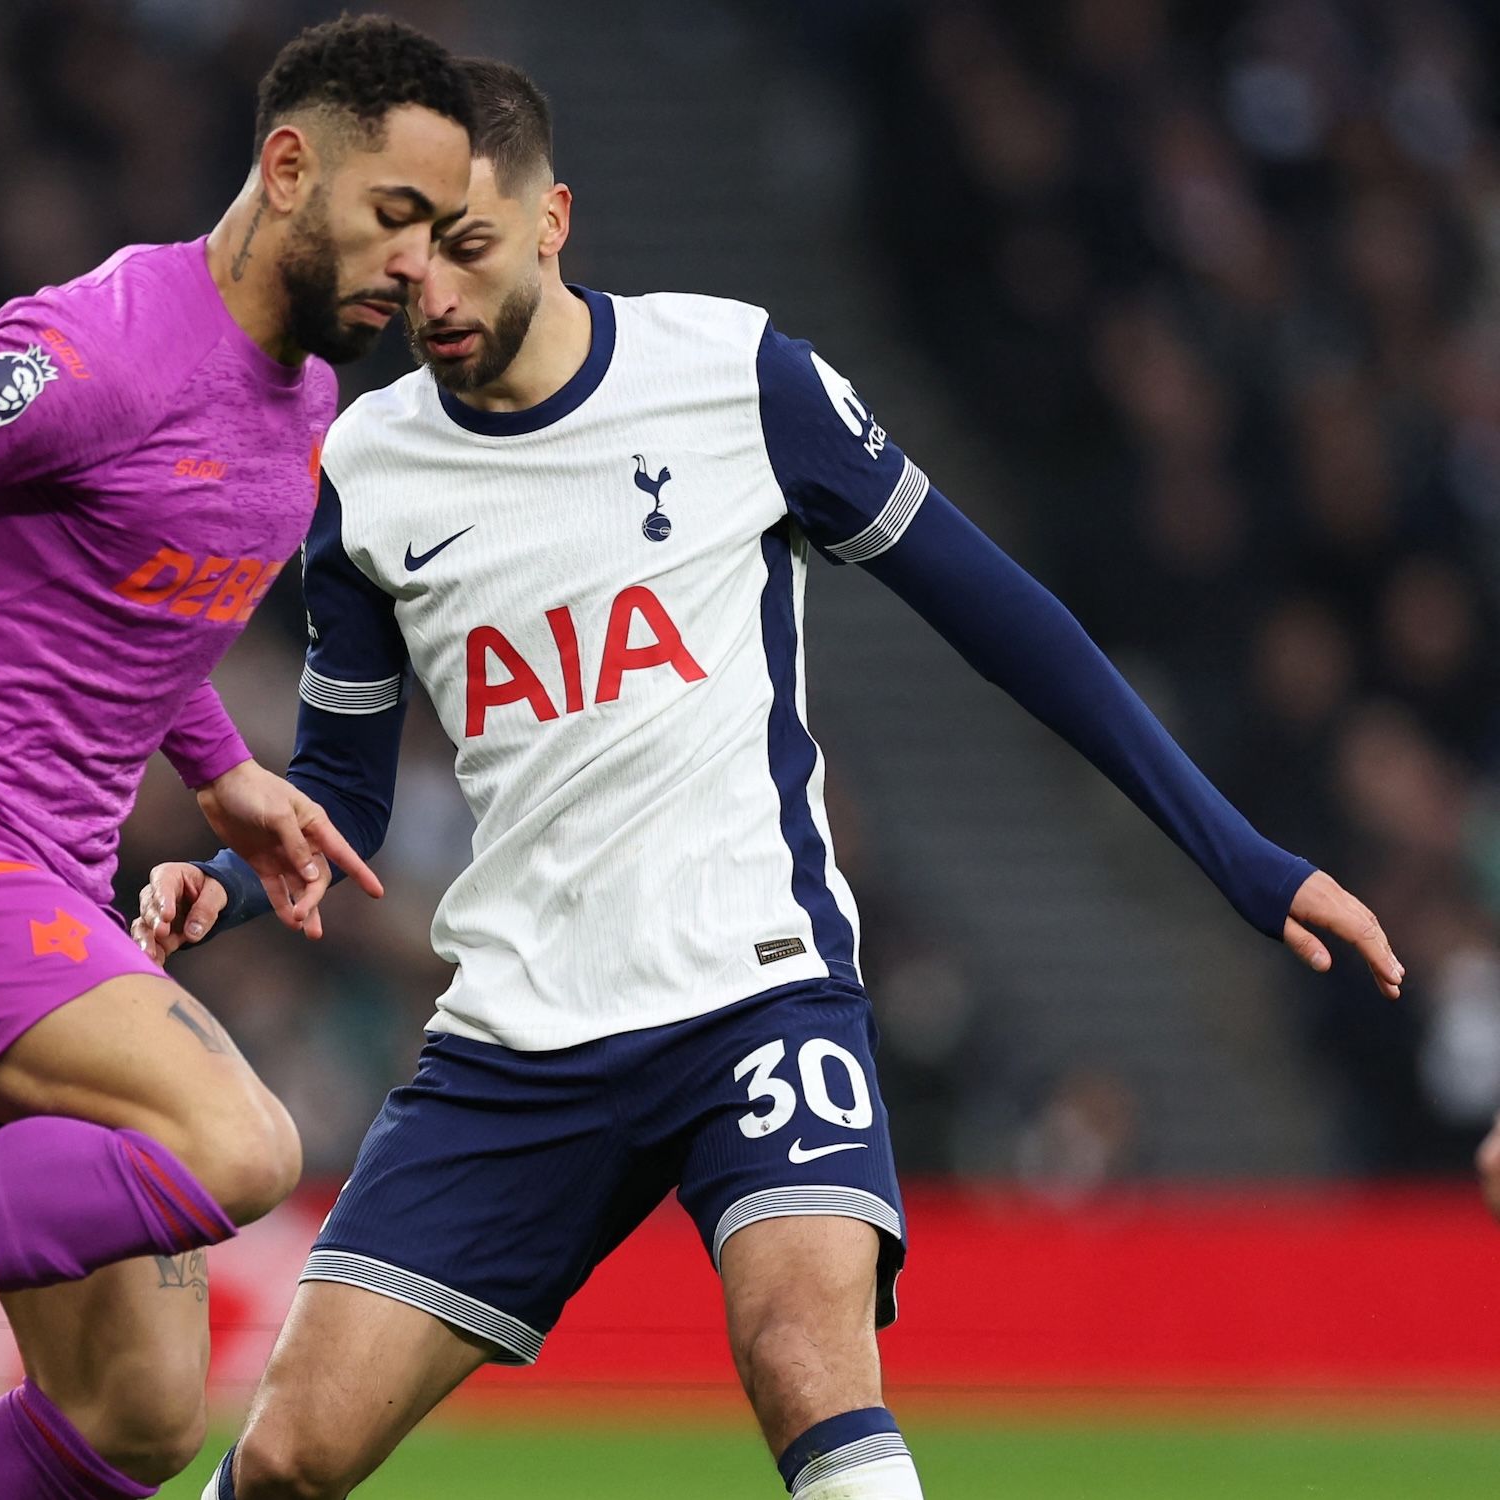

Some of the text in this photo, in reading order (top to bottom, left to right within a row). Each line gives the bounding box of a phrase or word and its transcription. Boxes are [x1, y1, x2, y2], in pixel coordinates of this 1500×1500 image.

[114, 548, 287, 622] DEBE
[465, 586, 708, 738] AIA
[733, 1037, 873, 1139] 30
